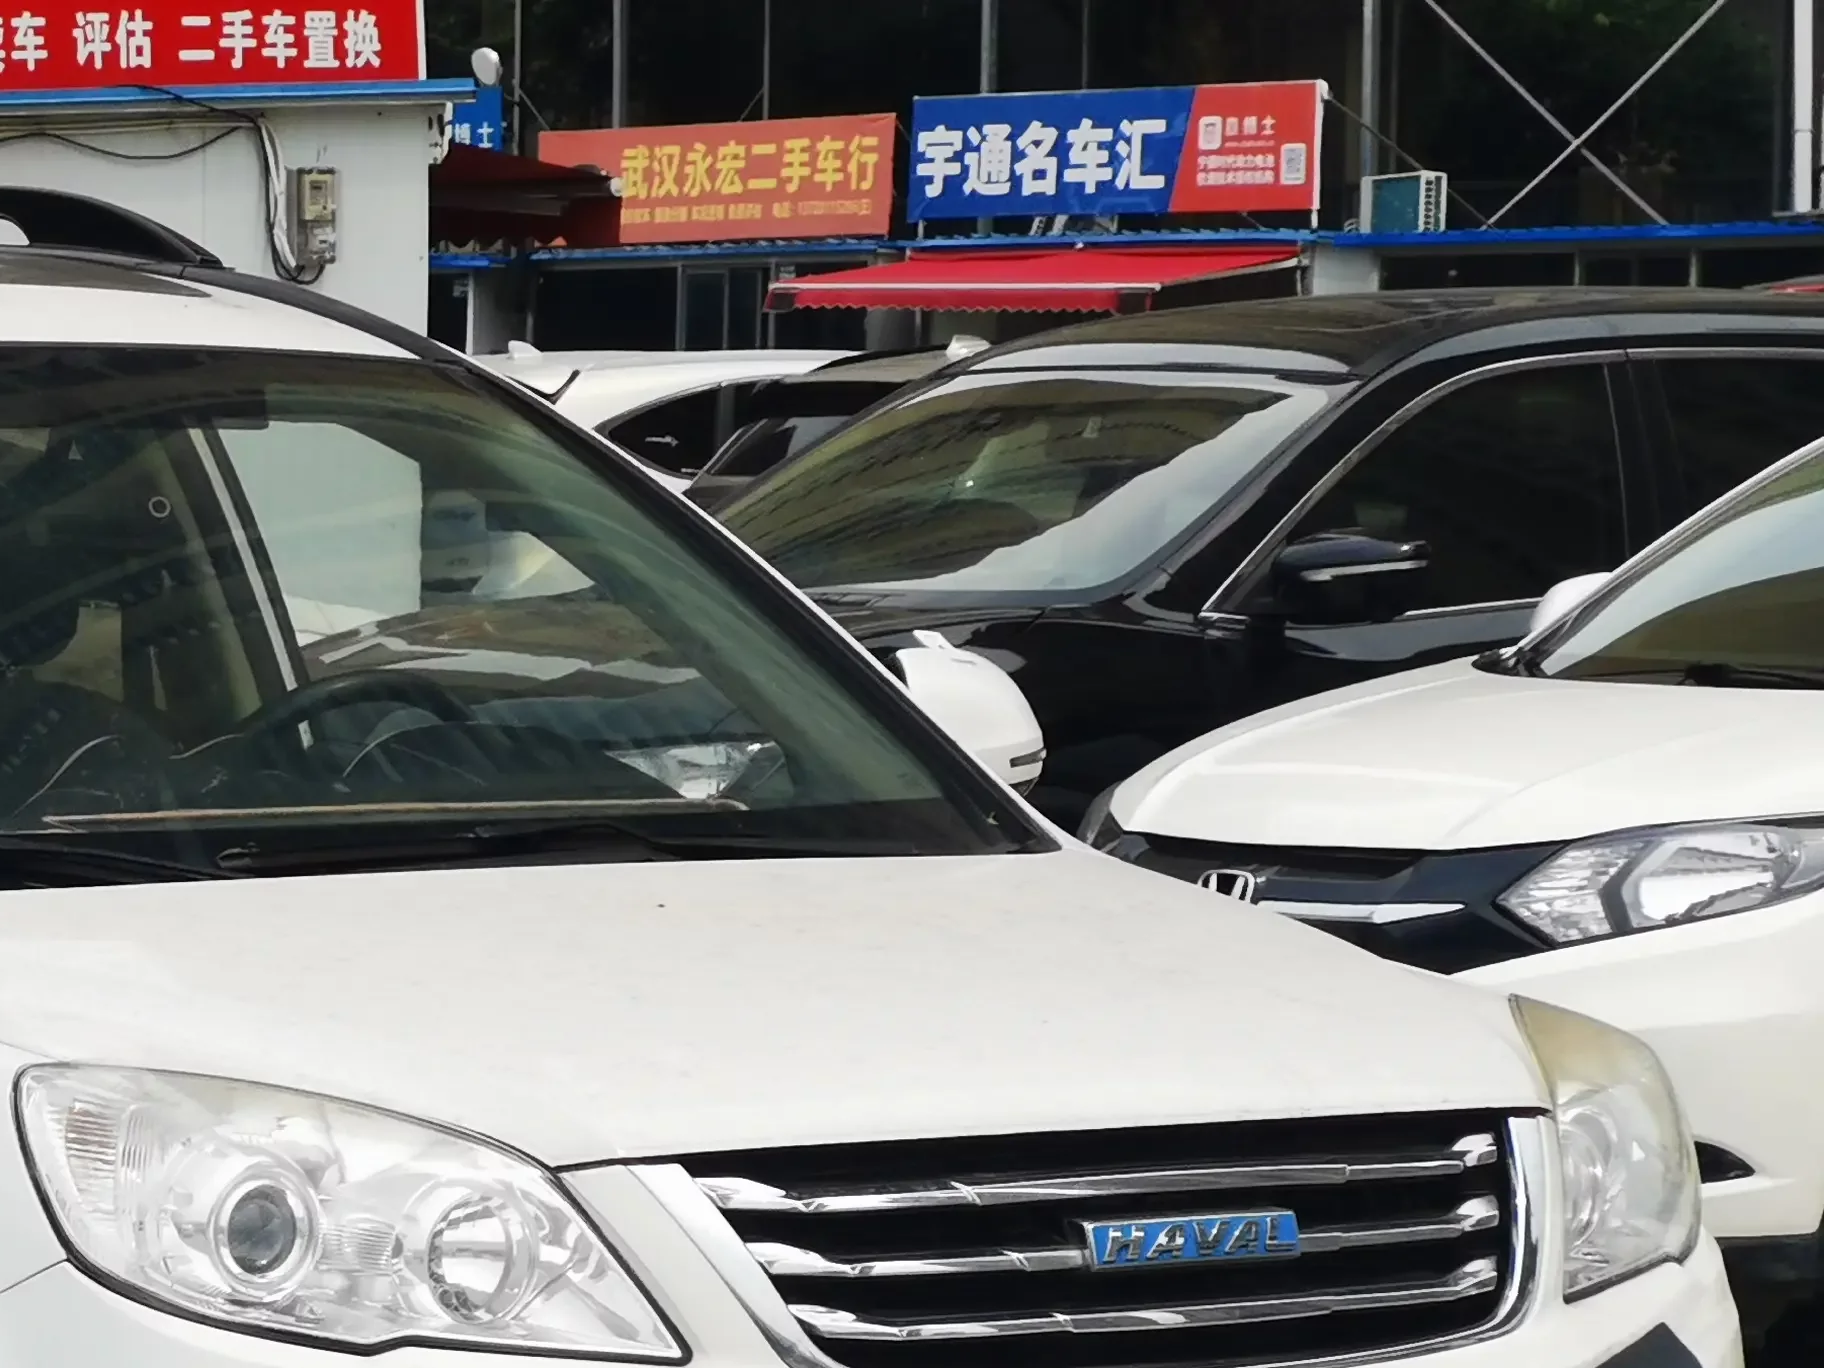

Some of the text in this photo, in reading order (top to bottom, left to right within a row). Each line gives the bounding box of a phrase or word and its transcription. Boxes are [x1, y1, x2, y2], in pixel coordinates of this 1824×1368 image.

[72, 9, 153, 70] 评估
[178, 9, 382, 69] 二手车置换
[620, 135, 880, 199] 武汉永宏二手车行
[916, 117, 1167, 198] 宇通名车汇
[1103, 1216, 1297, 1264] HAVAL
